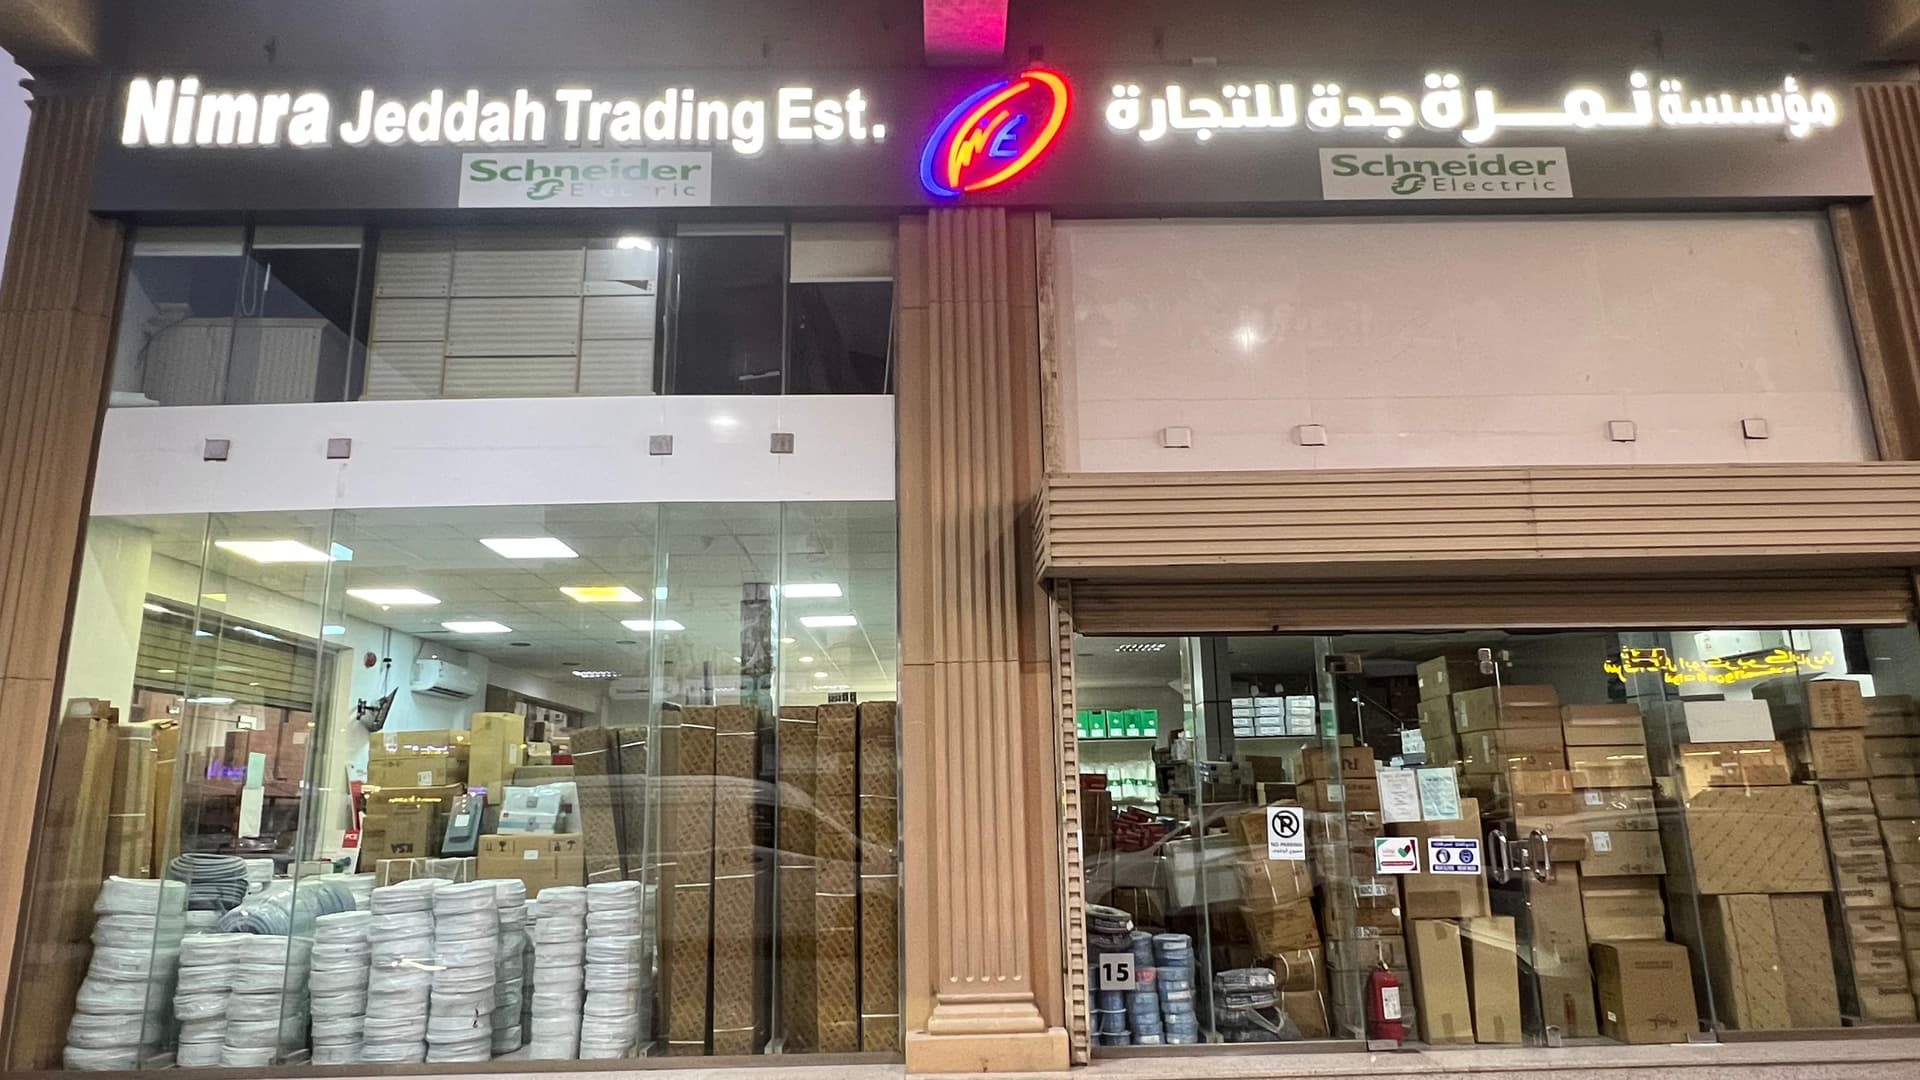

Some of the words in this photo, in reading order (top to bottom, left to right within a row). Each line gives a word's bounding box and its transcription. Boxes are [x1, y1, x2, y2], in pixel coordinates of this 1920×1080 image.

[121, 77, 330, 147] Nimra
[340, 88, 545, 144] Jeddah
[556, 87, 765, 155] Trading
[777, 87, 886, 141] Est.
[1105, 83, 1298, 142] للتجارة
[1307, 83, 1415, 140] جدة
[1659, 75, 1837, 138] مؤسسة
[469, 158, 702, 182] Schneider
[1330, 153, 1557, 177] Schneider
[1433, 178, 1557, 192] Electric
[1103, 963, 1129, 982] 15
